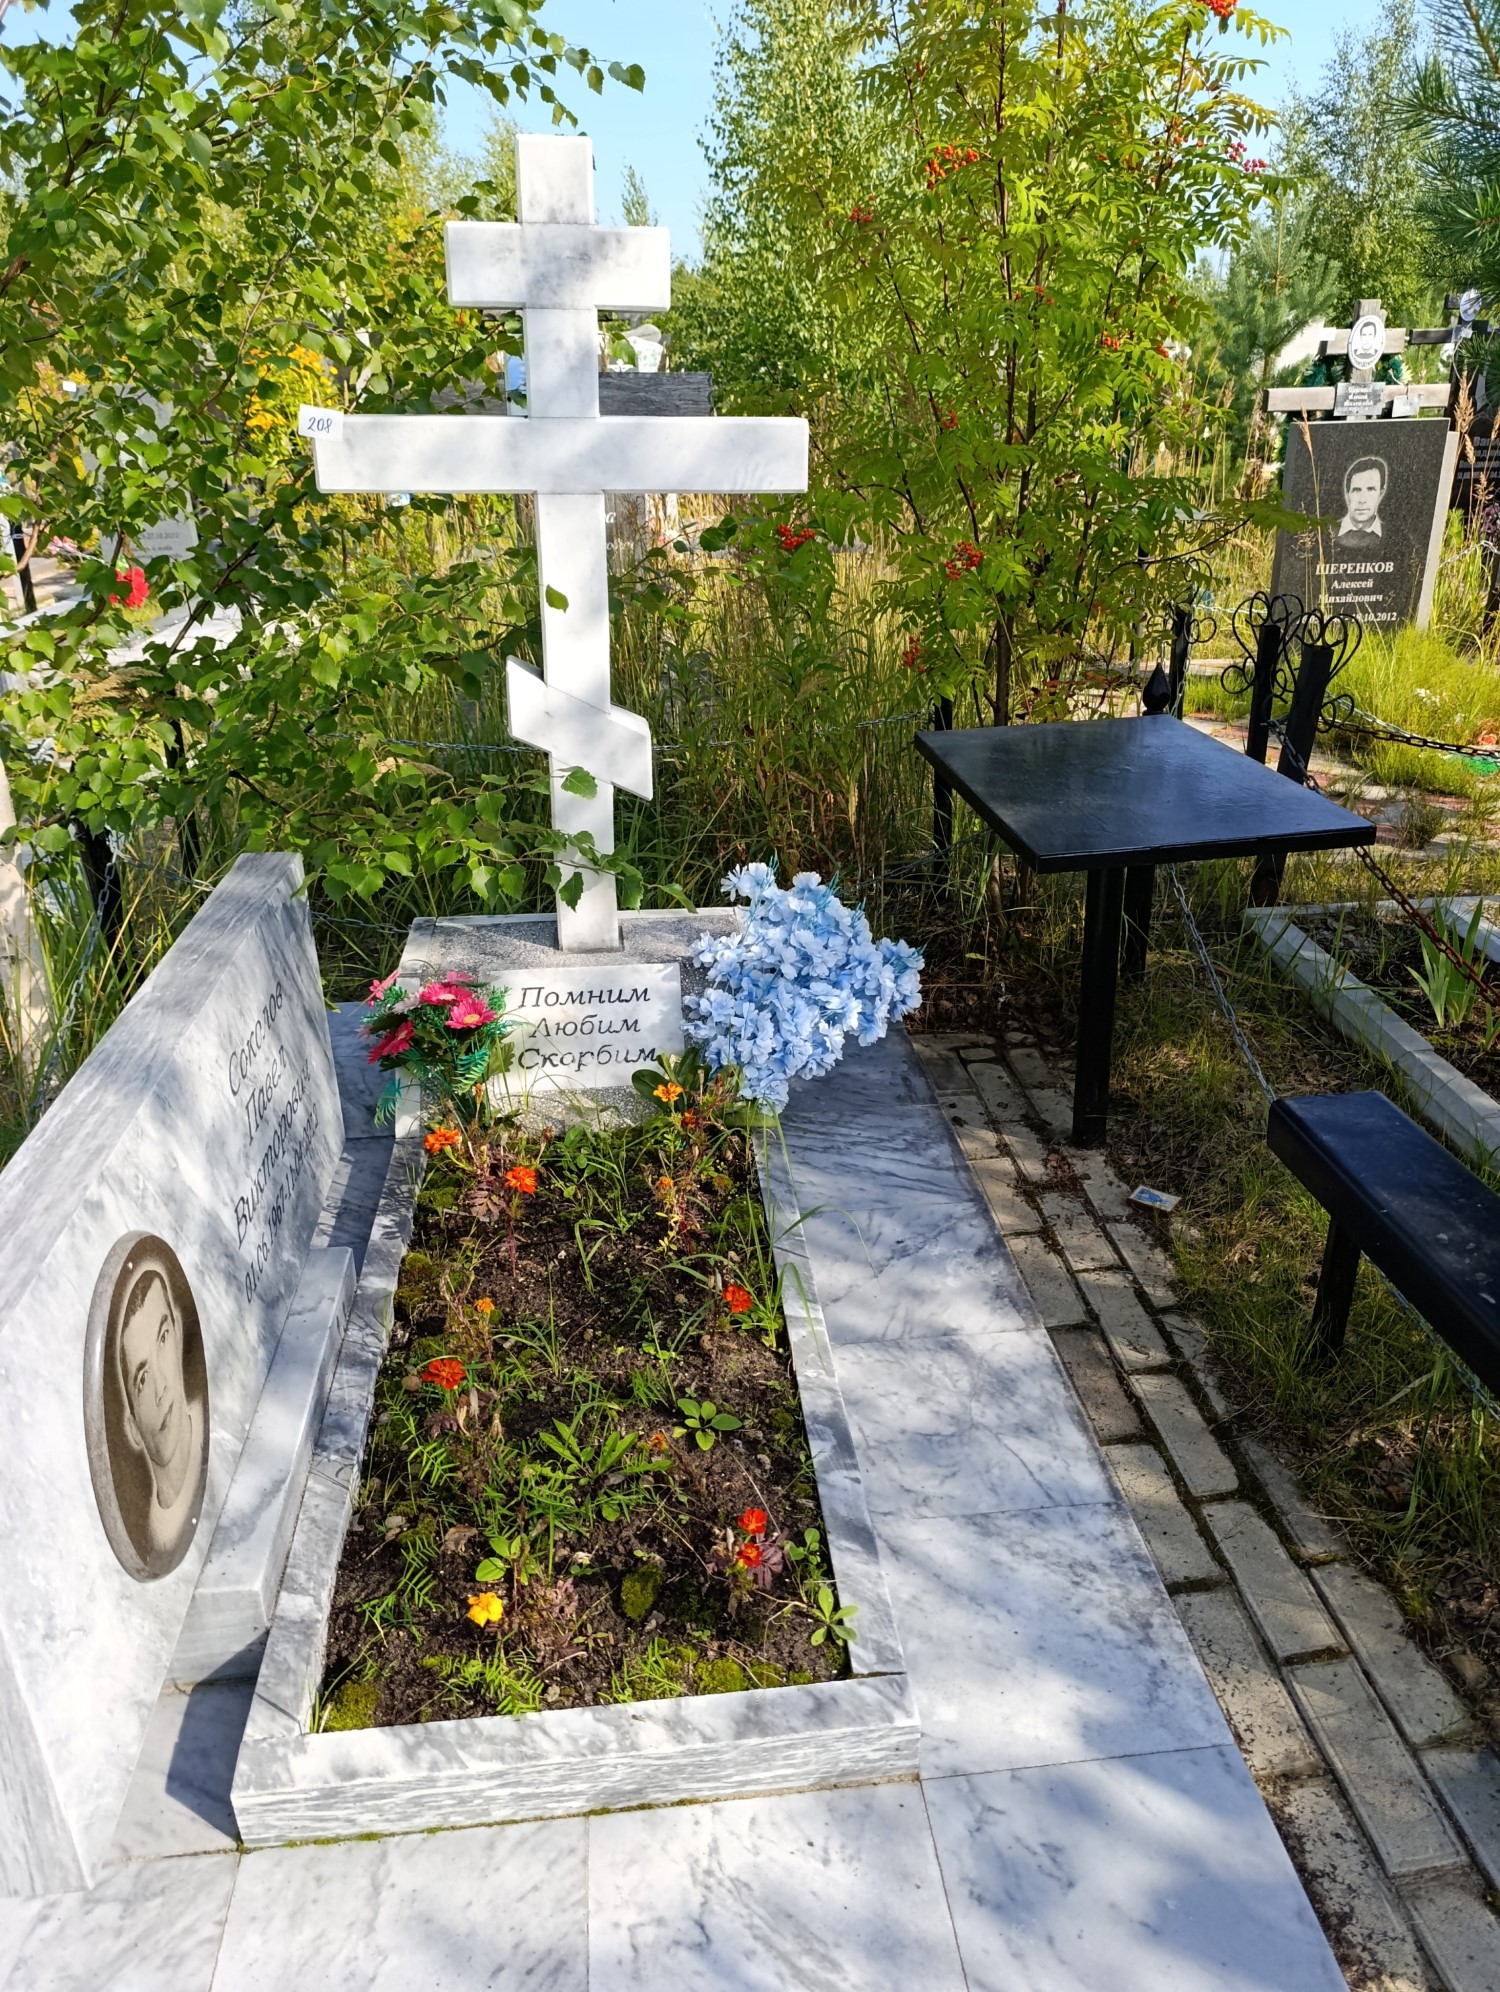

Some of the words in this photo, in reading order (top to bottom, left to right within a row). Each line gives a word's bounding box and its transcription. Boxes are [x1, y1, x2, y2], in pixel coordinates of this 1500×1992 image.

[307, 416, 333, 433] 208
[1331, 578, 1374, 589] Алексей
[1318, 592, 1384, 604] Михайлович
[517, 986, 651, 1008] Помним
[528, 1014, 641, 1038] Любим
[228, 980, 283, 1097] Соколов
[517, 1044, 657, 1072] Скорбим
[245, 1044, 287, 1147] Павел
[234, 1058, 311, 1250] Викторович
